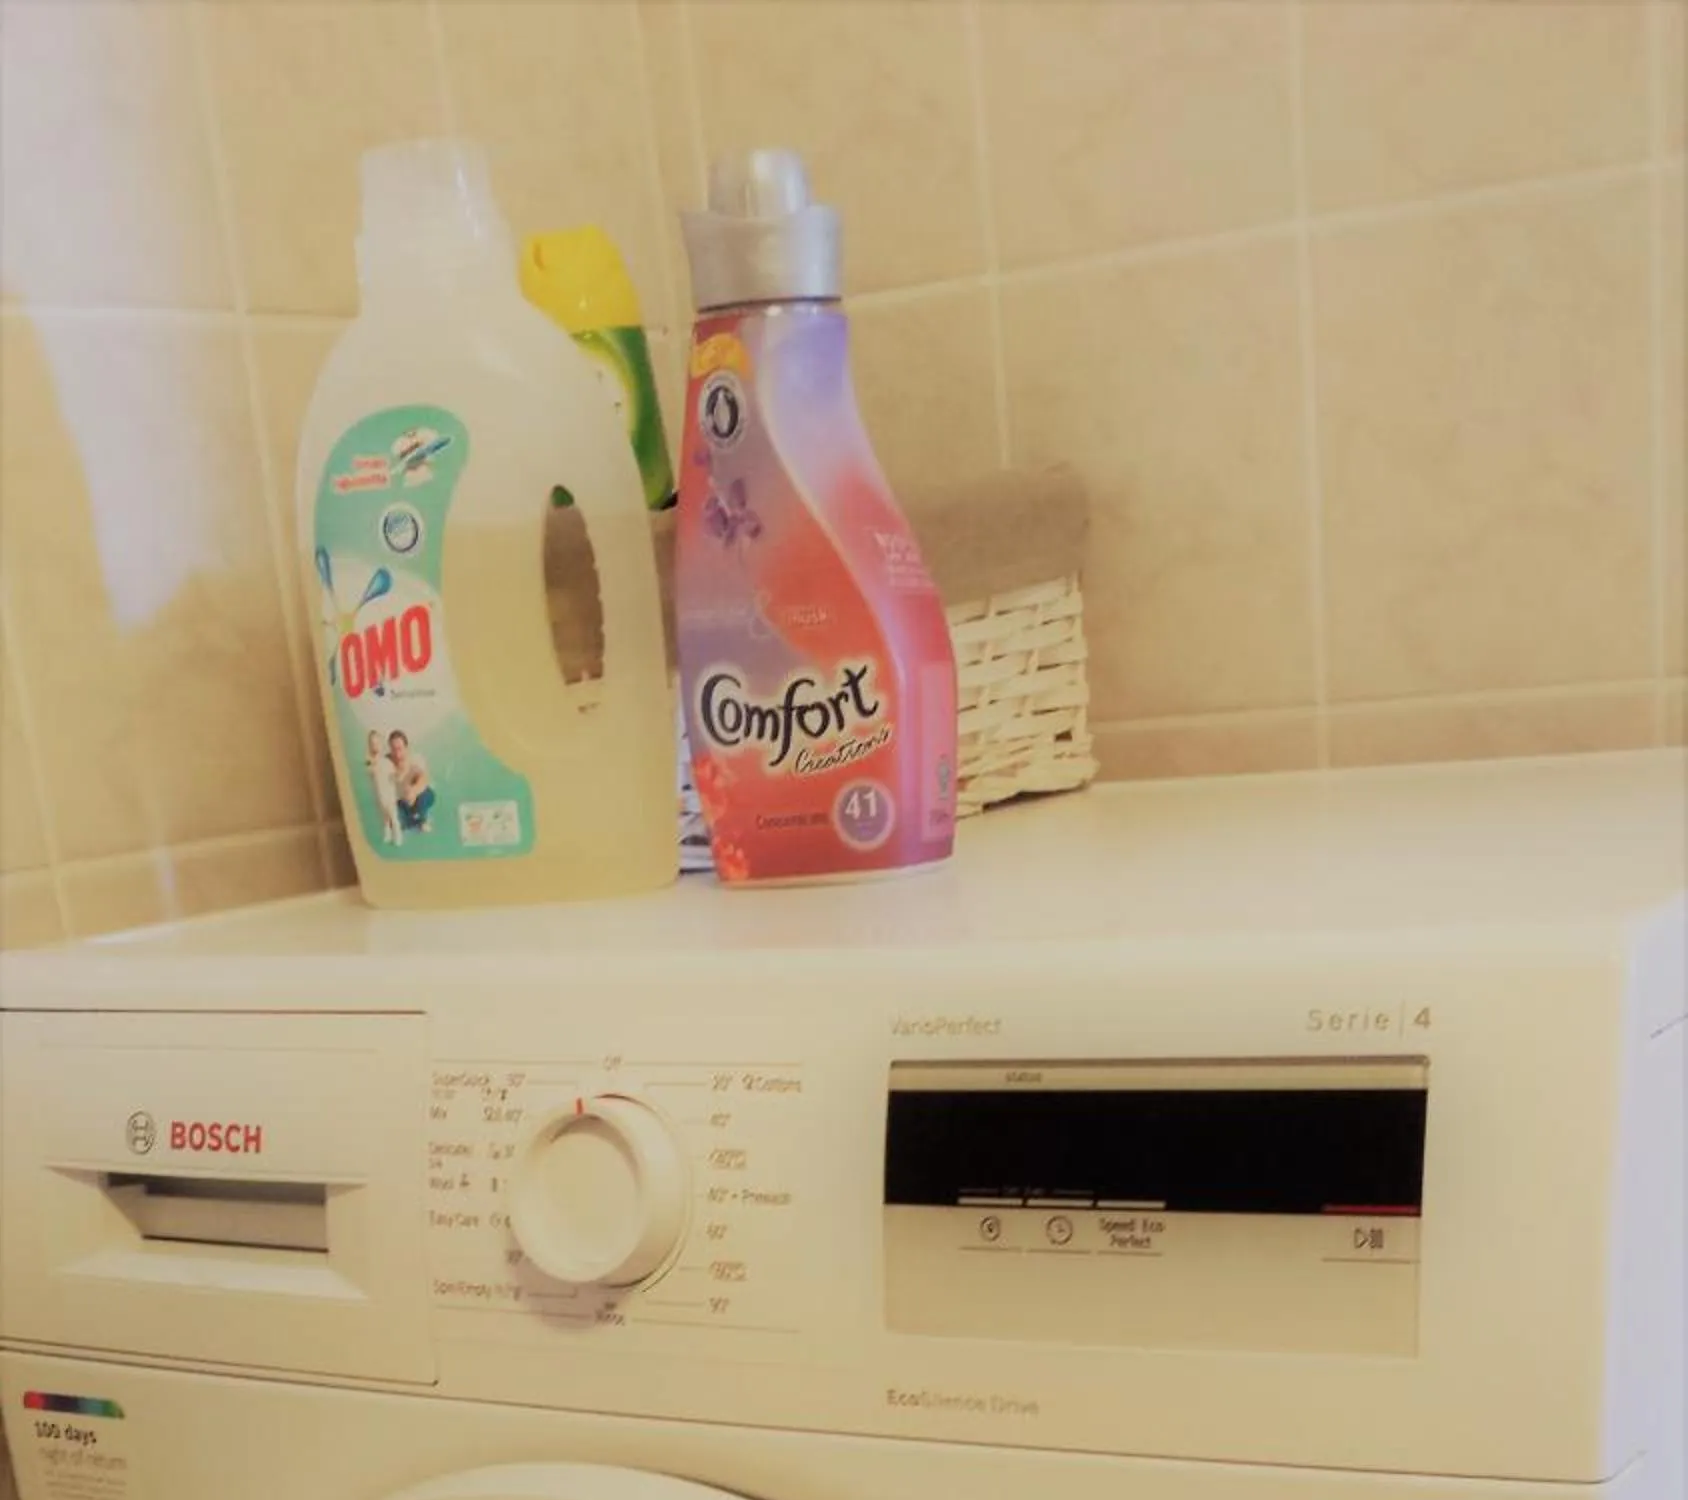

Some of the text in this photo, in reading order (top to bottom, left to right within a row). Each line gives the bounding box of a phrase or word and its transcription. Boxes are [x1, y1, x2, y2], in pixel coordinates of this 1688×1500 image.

[341, 604, 434, 700] OMO
[700, 664, 881, 768] Comfort
[794, 727, 892, 778] Creations
[844, 791, 879, 822] 41
[1304, 1005, 1433, 1033] Serie 4
[170, 1120, 262, 1154] BOSCH
[64, 1423, 98, 1447] days
